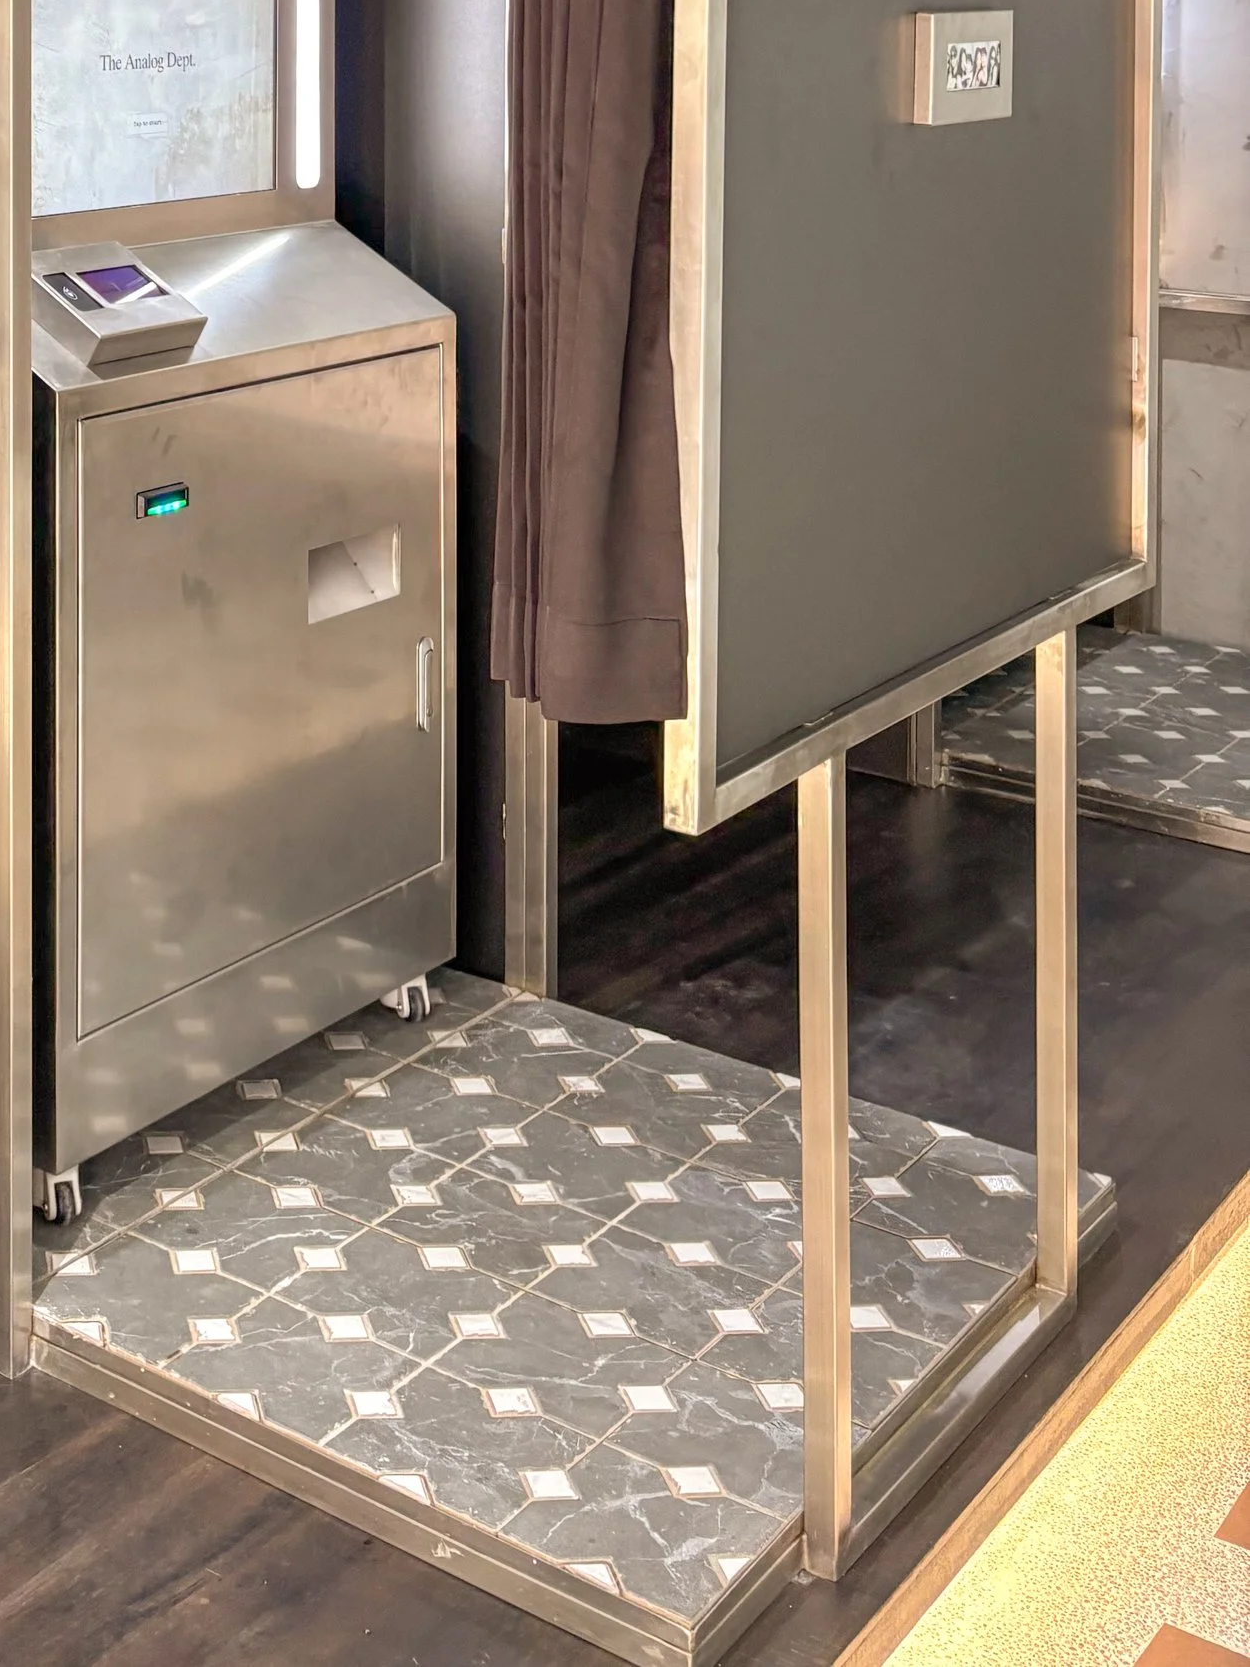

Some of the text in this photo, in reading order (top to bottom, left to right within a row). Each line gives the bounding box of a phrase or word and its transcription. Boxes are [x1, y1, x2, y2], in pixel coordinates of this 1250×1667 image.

[99, 52, 196, 73] The Analog Dept.
